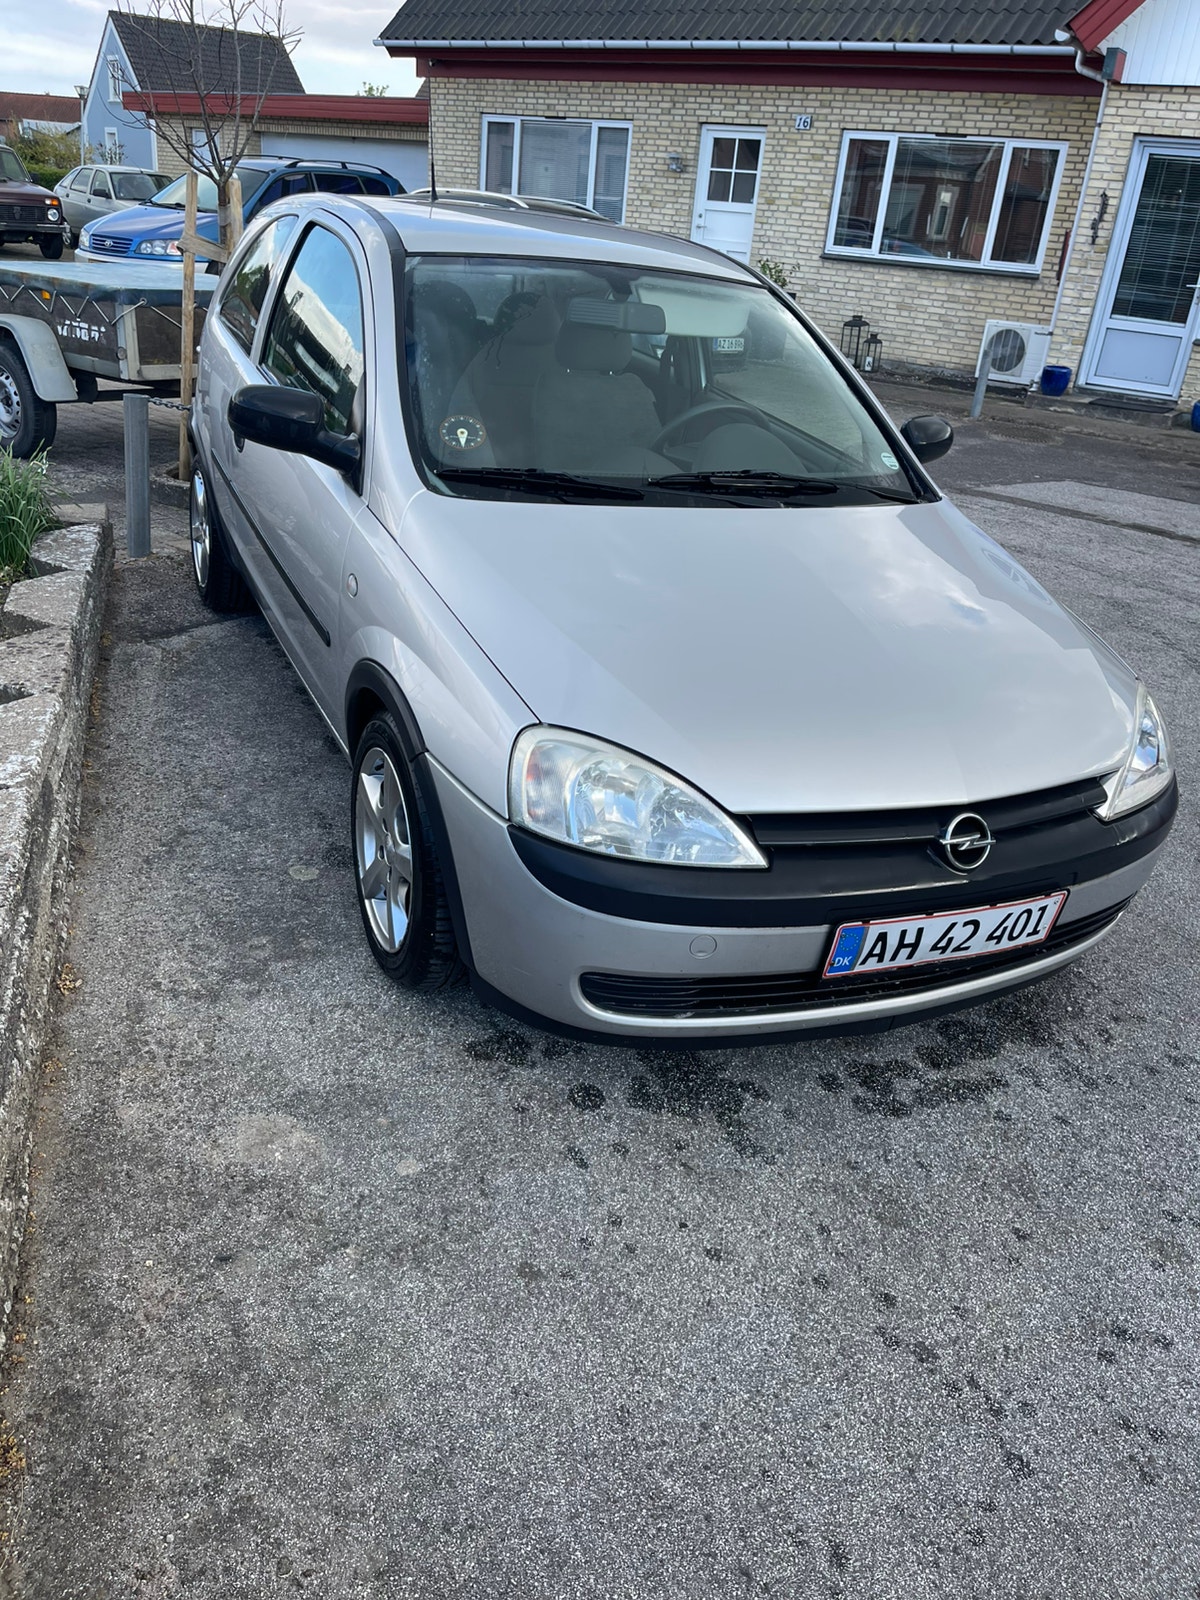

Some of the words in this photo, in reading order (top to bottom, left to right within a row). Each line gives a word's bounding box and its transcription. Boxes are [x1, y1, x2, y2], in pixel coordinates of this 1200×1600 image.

[797, 116, 809, 128] 16
[718, 339, 726, 349] AZ
[859, 926, 924, 966] AH
[929, 919, 981, 955] 42
[985, 904, 1049, 946] 401
[834, 955, 852, 967] DK
